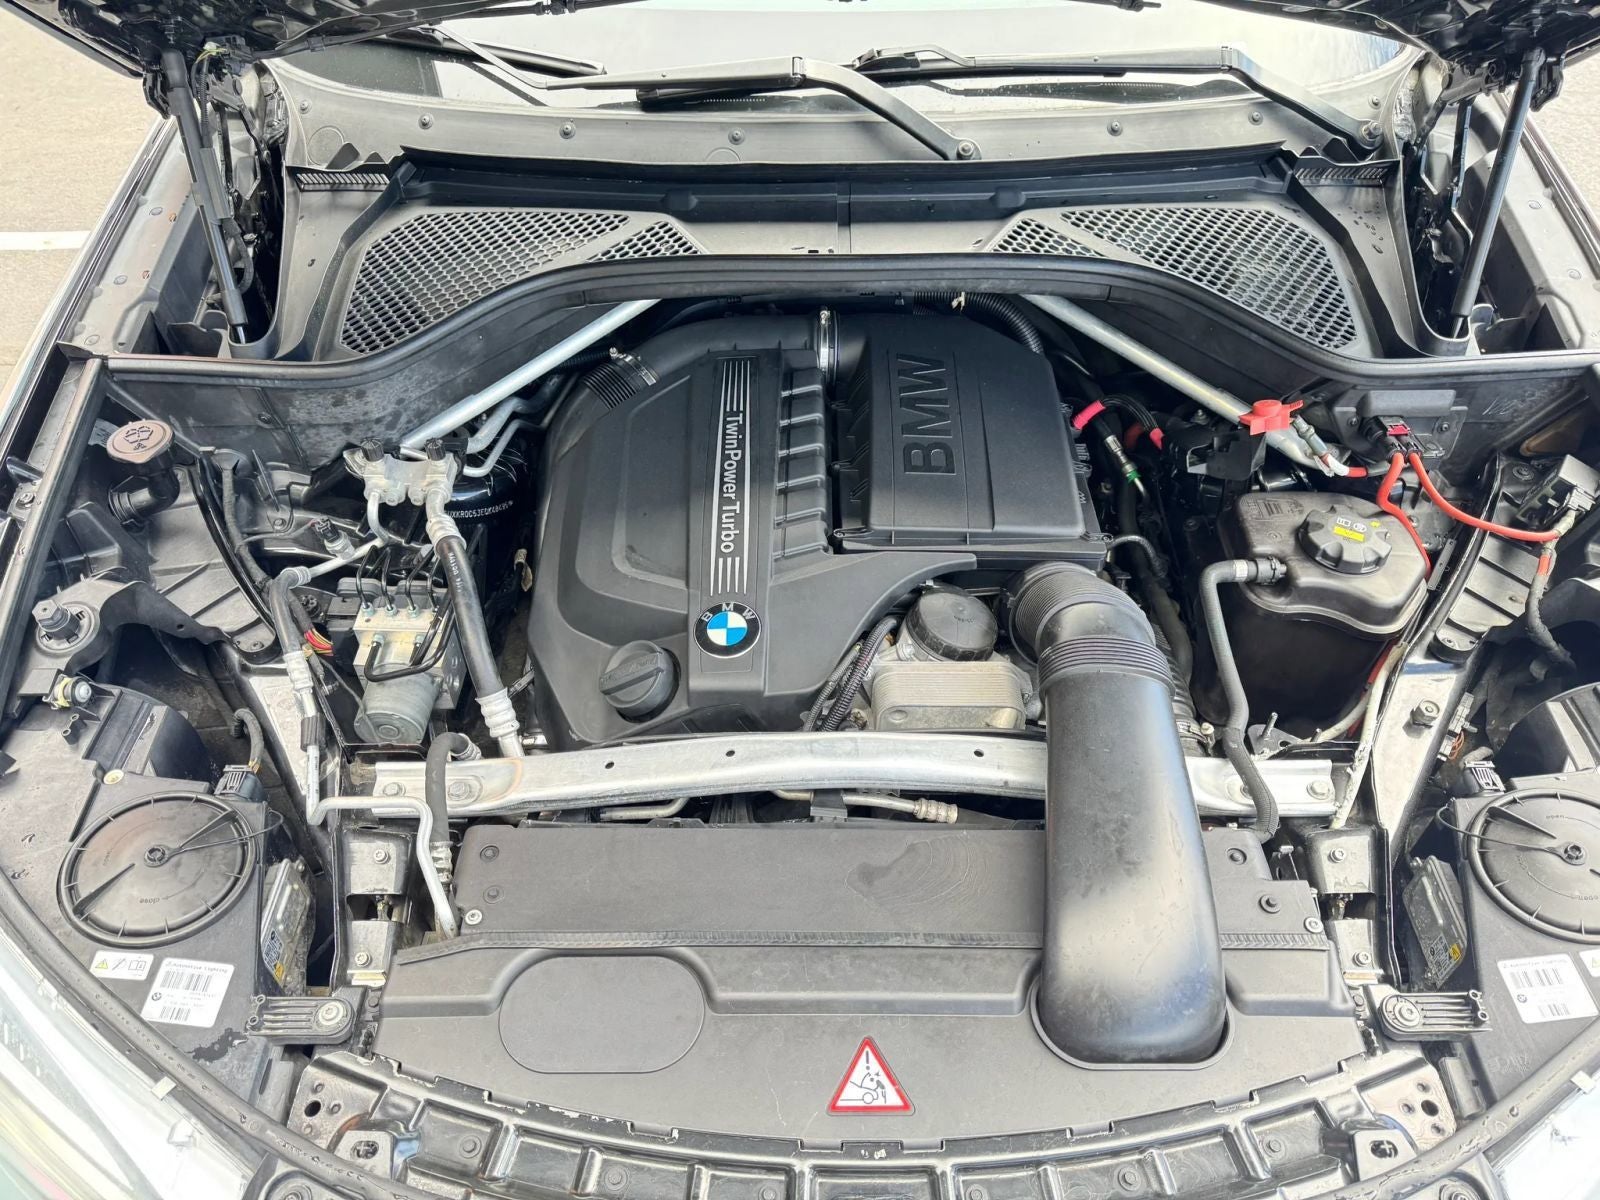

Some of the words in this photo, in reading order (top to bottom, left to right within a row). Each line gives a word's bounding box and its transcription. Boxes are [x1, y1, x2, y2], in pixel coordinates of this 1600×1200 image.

[896, 353, 956, 475] BMW
[722, 413, 743, 500] TwinPower
[720, 501, 740, 553] Turbo
[701, 602, 756, 622] BMW
